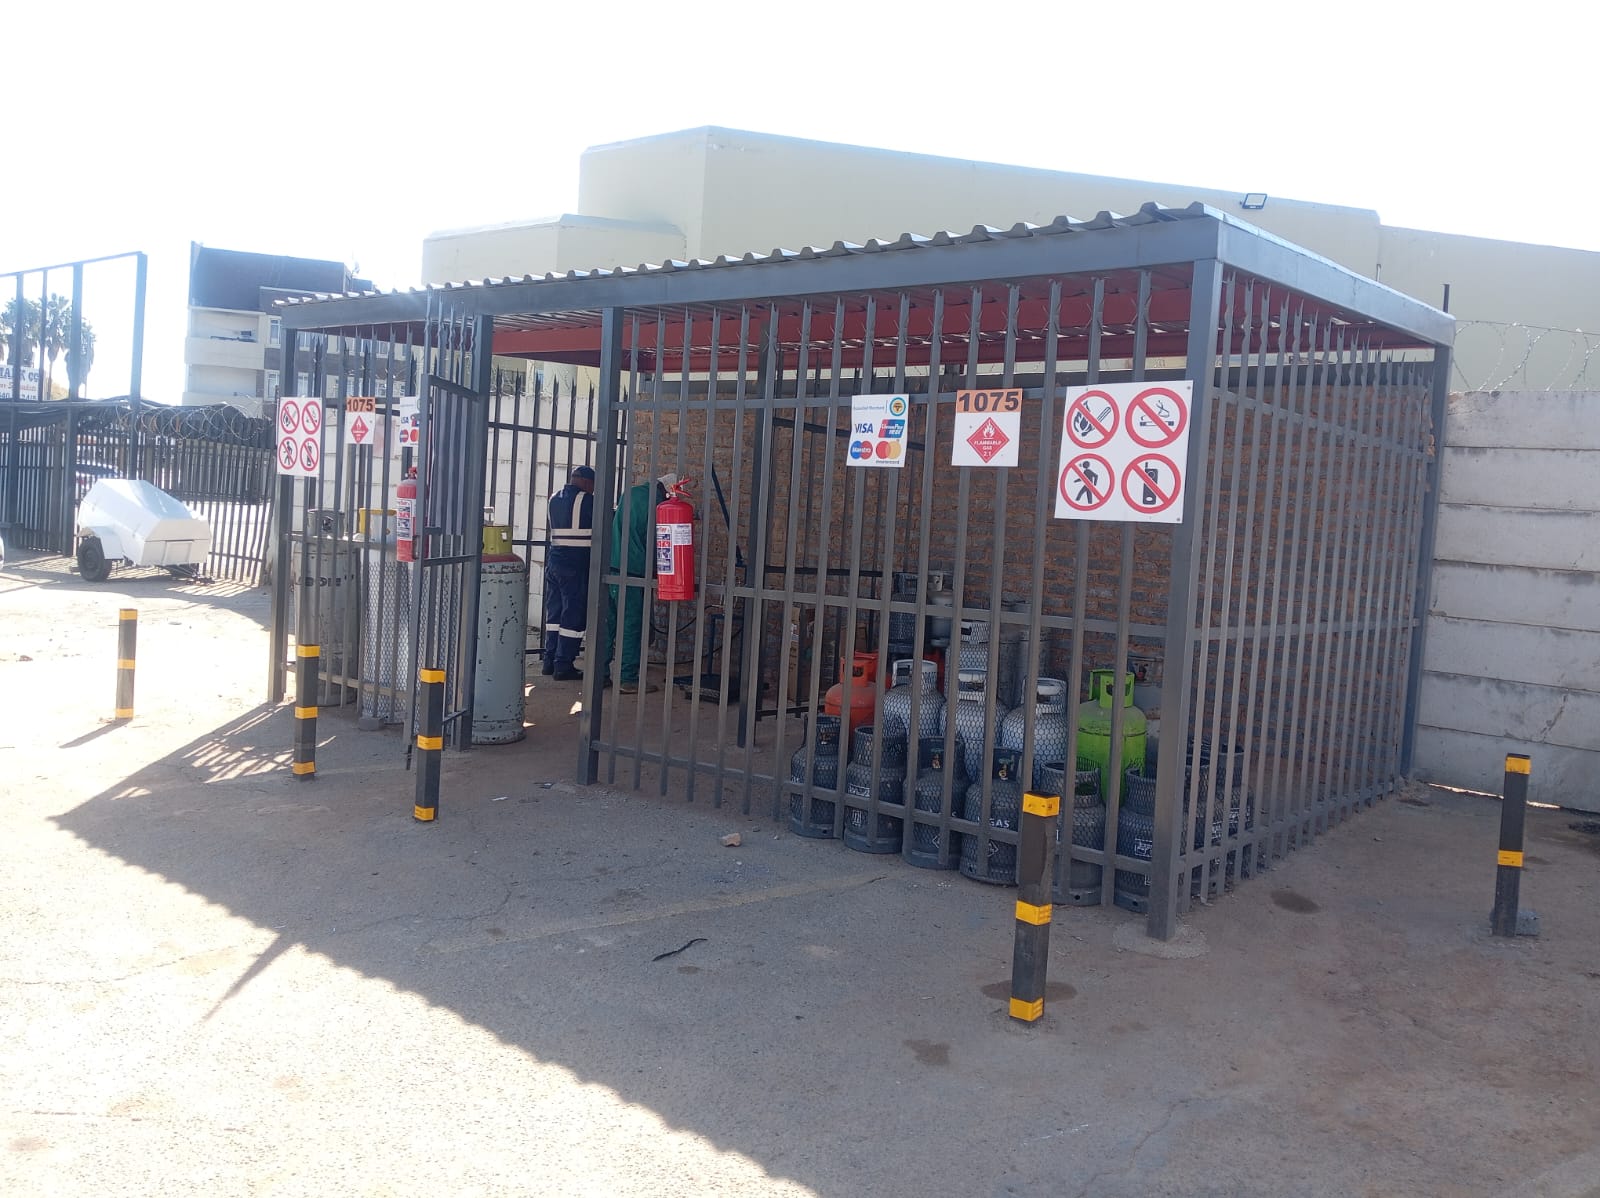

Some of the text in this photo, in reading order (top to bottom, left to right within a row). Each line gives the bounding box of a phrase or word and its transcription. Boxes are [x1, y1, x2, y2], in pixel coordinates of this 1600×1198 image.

[347, 398, 373, 412] 1075
[959, 392, 1018, 412] 1075
[855, 423, 874, 434] VISA
